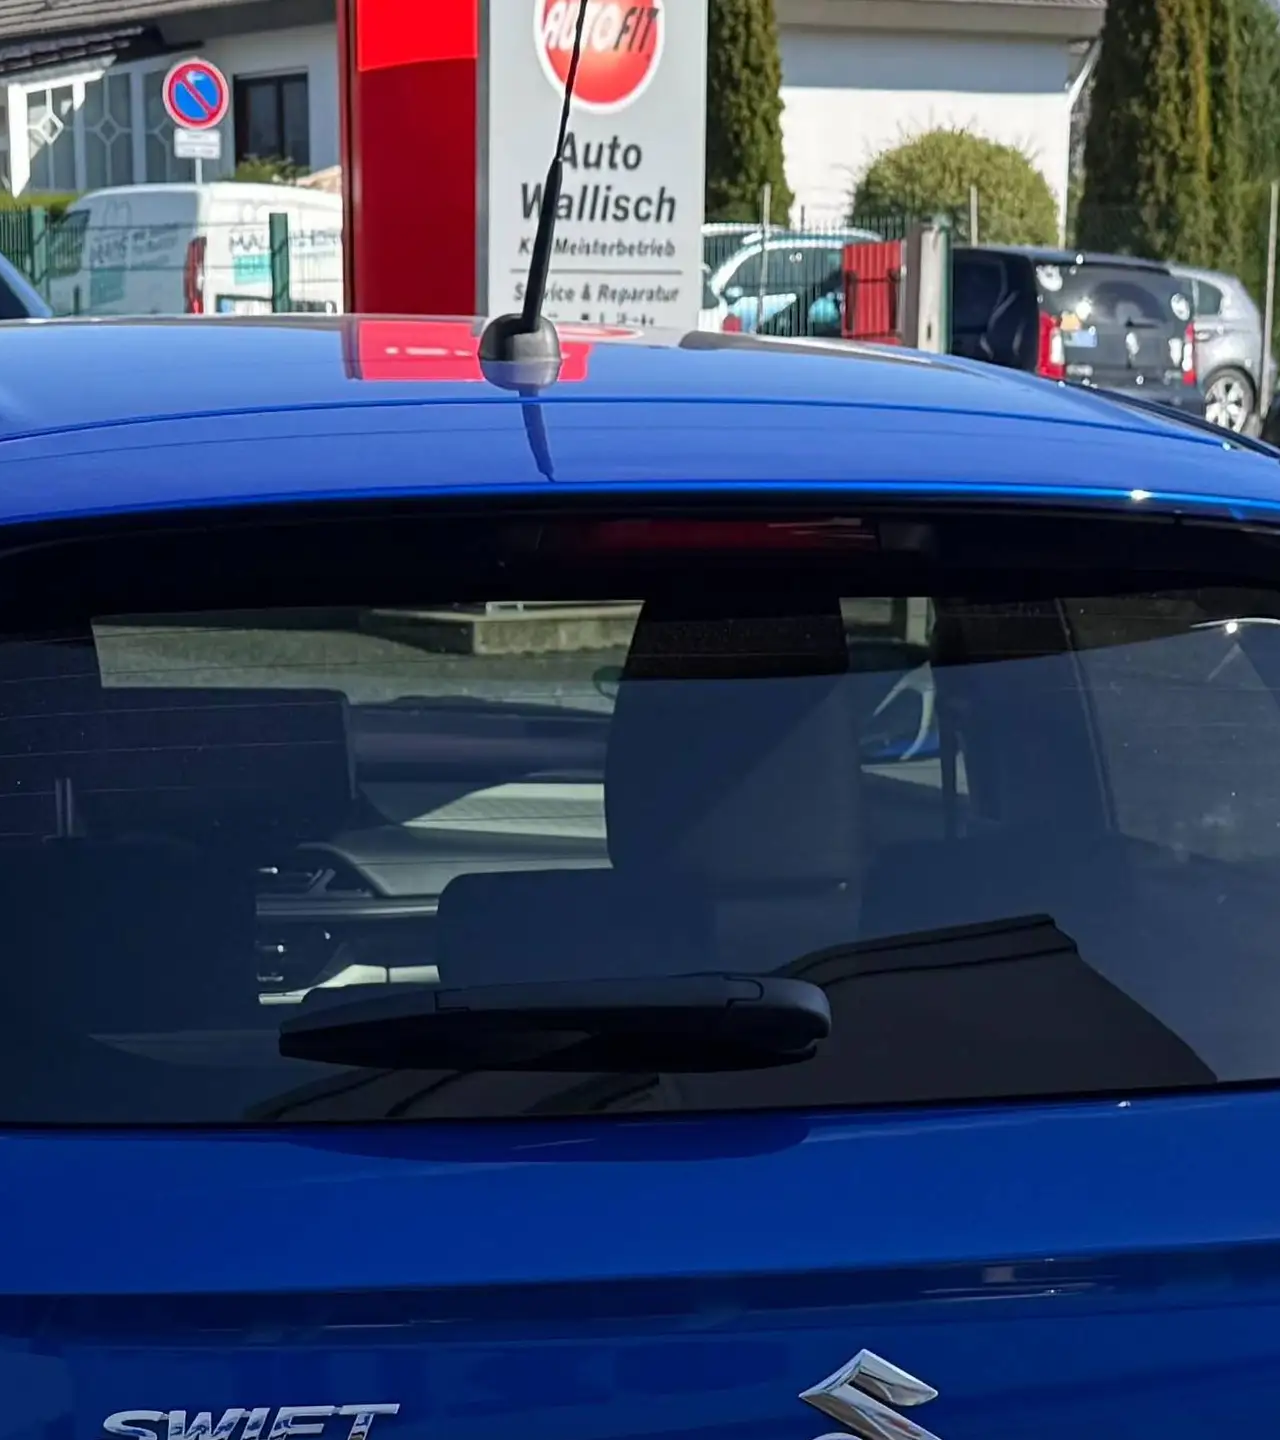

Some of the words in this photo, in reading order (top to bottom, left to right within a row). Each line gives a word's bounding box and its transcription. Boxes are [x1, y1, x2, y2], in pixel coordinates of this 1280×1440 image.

[559, 131, 642, 171] Auto
[521, 183, 676, 223] Wallisch
[597, 284, 680, 306] Reparatur
